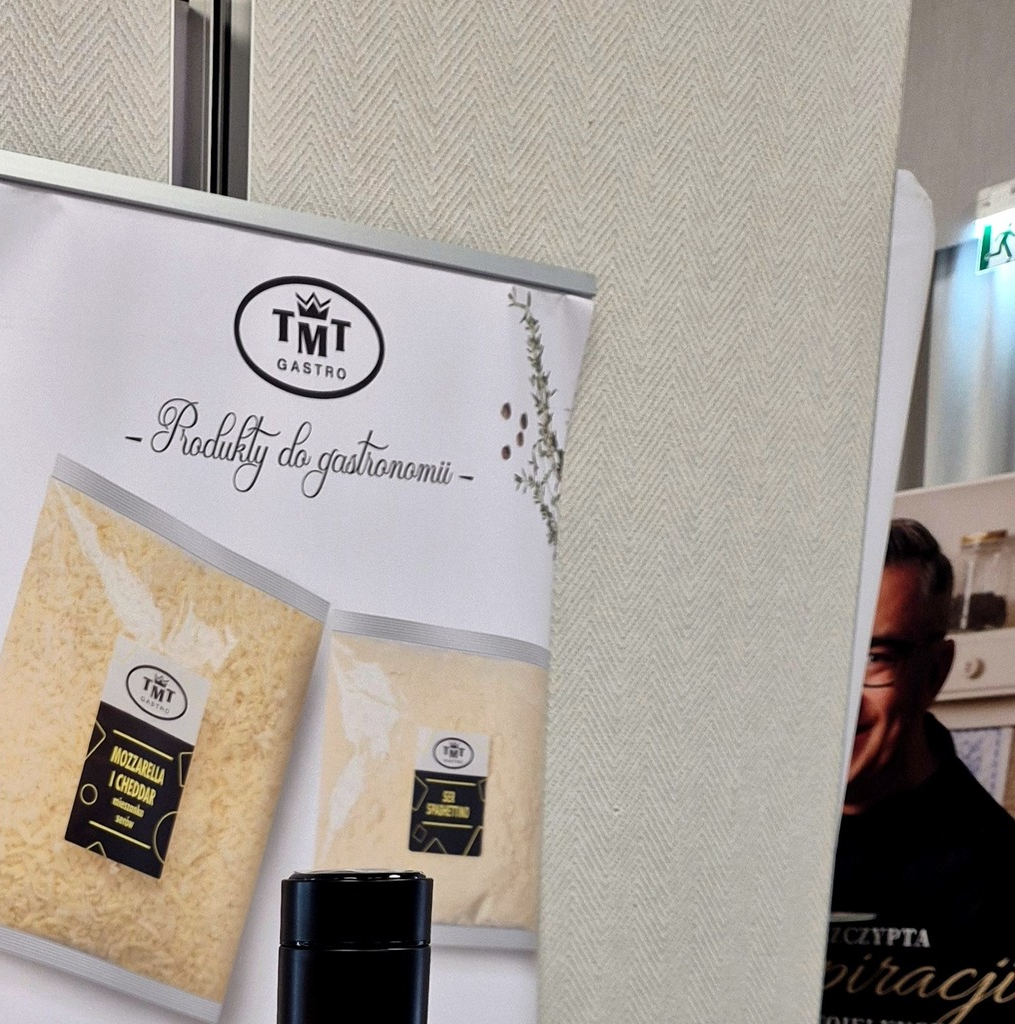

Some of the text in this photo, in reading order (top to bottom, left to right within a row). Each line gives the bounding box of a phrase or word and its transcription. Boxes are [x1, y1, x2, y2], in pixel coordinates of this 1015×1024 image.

[273, 309, 351, 357] TMT
[277, 358, 346, 380] GASTRO
[150, 398, 453, 498] Produkty do gastronomii
[143, 676, 176, 703] TMT
[110, 746, 165, 785] MOZZARELLA
[443, 746, 465, 758] TMT
[108, 770, 156, 806] I CHEDDAR
